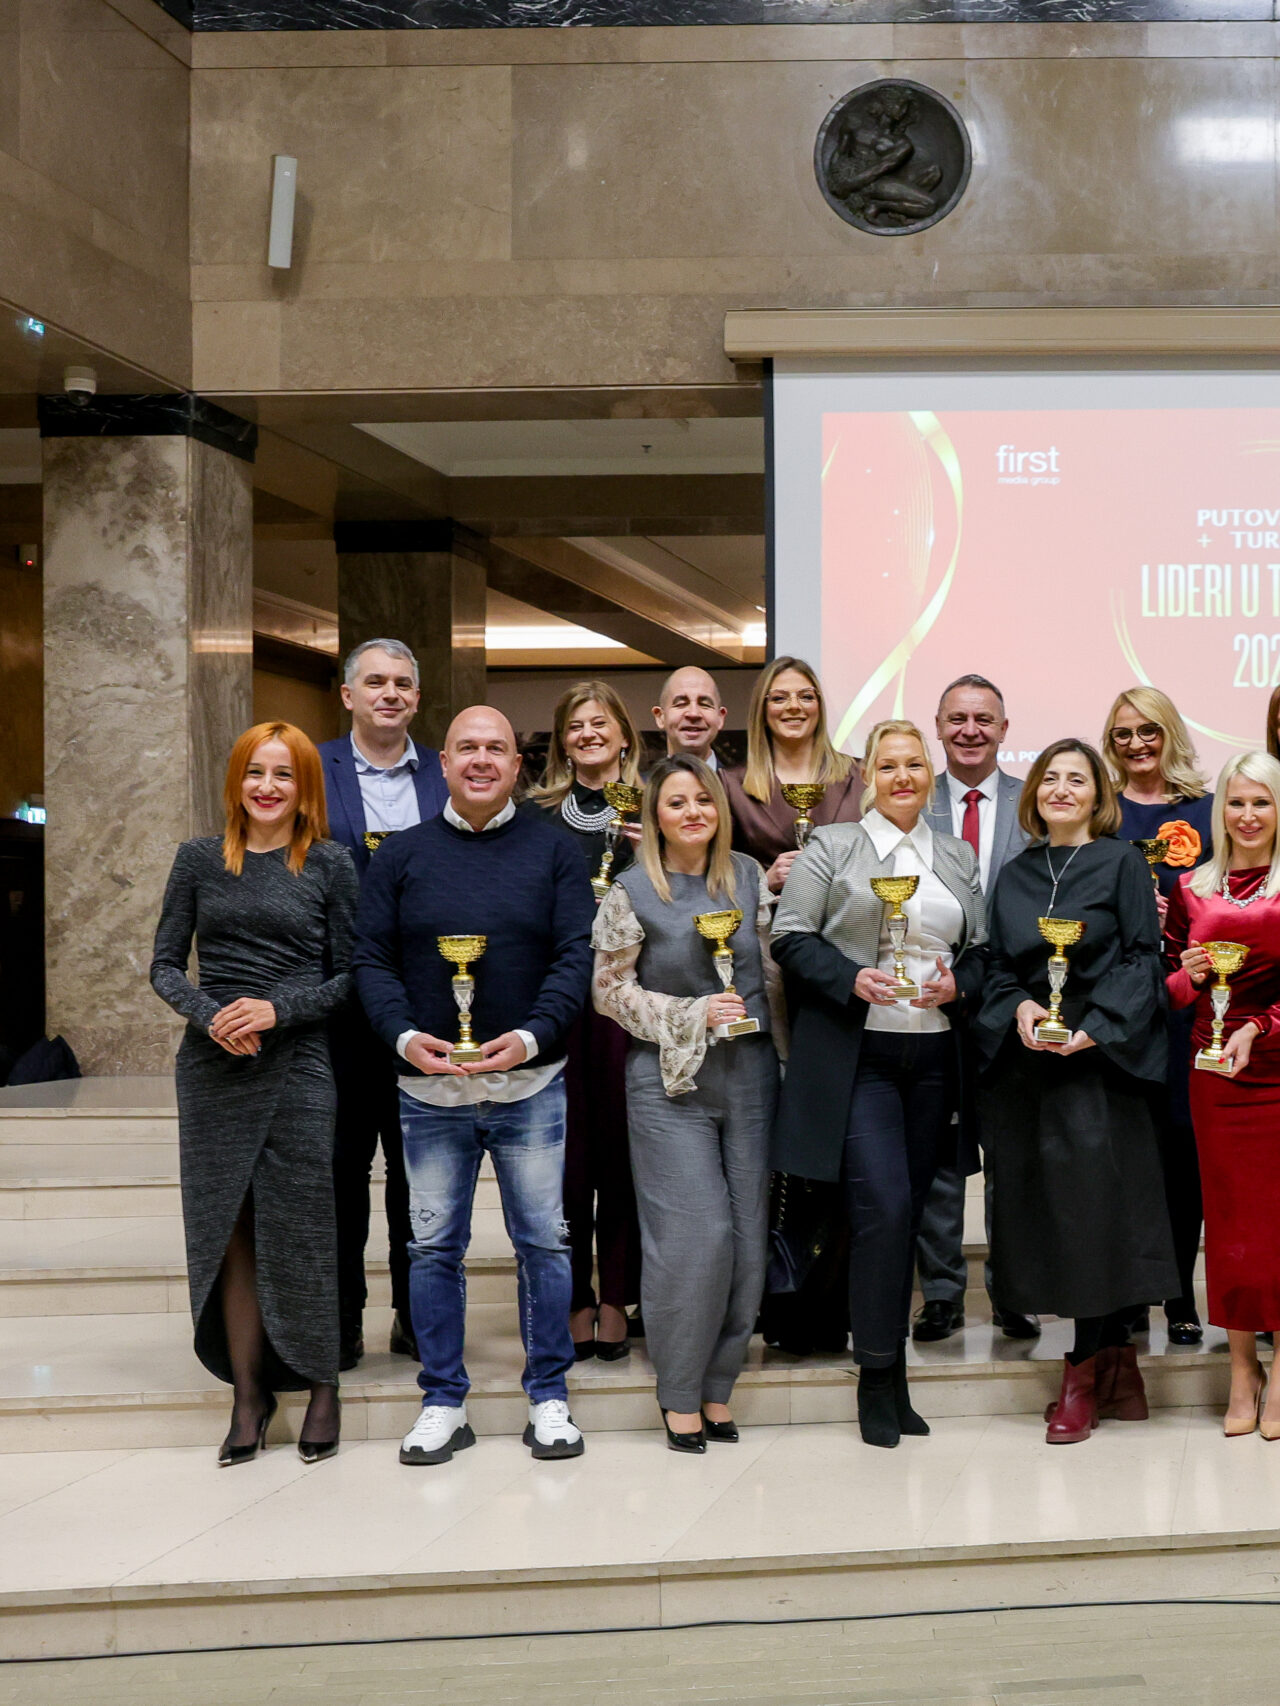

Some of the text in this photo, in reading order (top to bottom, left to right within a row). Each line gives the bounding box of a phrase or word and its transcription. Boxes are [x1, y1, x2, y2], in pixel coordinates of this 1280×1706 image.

[995, 444, 1061, 473] first
[1141, 564, 1232, 617] LIDERI
[1240, 564, 1260, 617] U
